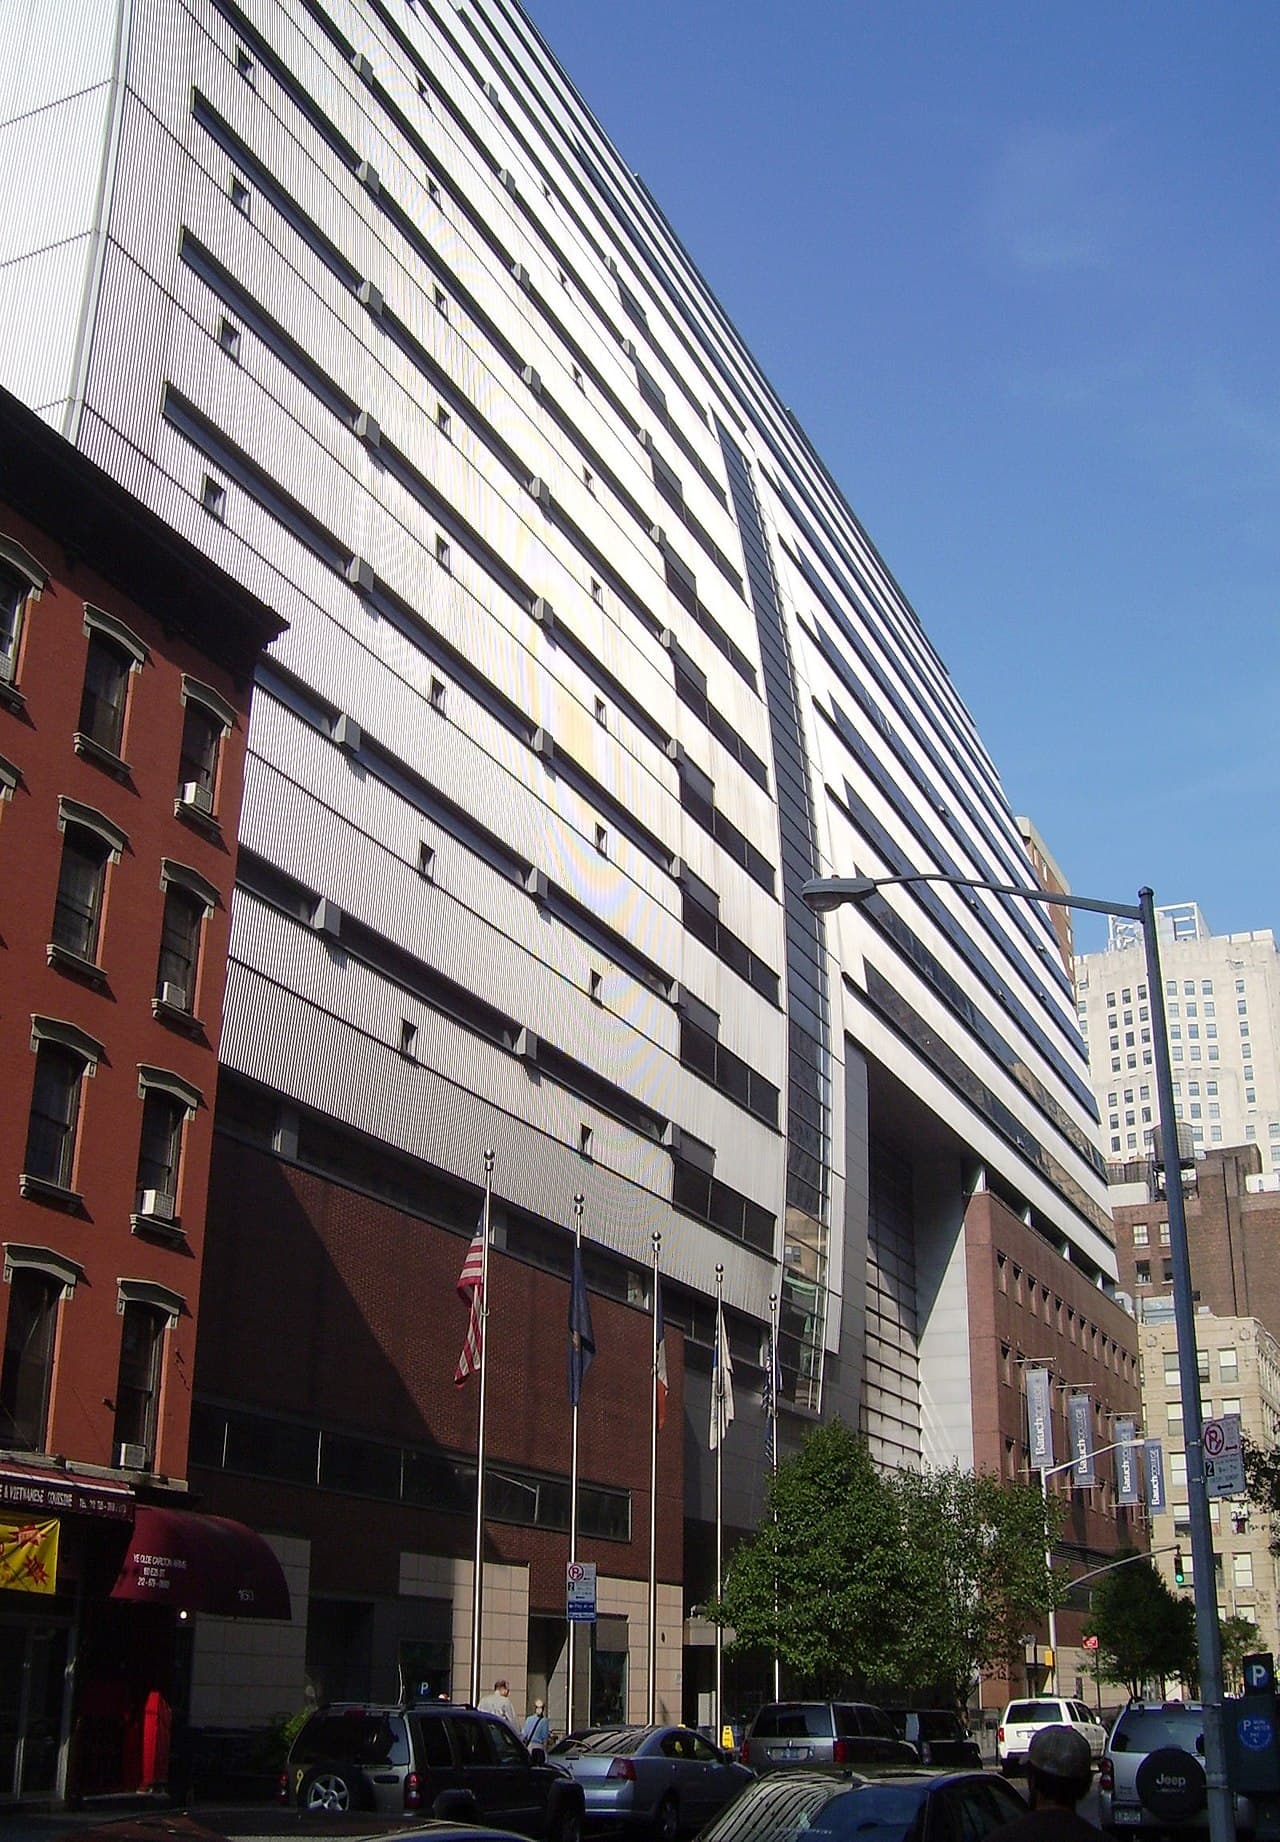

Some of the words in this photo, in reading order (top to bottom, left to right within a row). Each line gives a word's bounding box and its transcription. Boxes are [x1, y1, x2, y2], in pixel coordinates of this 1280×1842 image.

[1034, 1417, 1046, 1455] Baruch
[1252, 1665, 1266, 1687] P
[421, 1682, 429, 1695] P
[1156, 1773, 1186, 1787] Jeep
